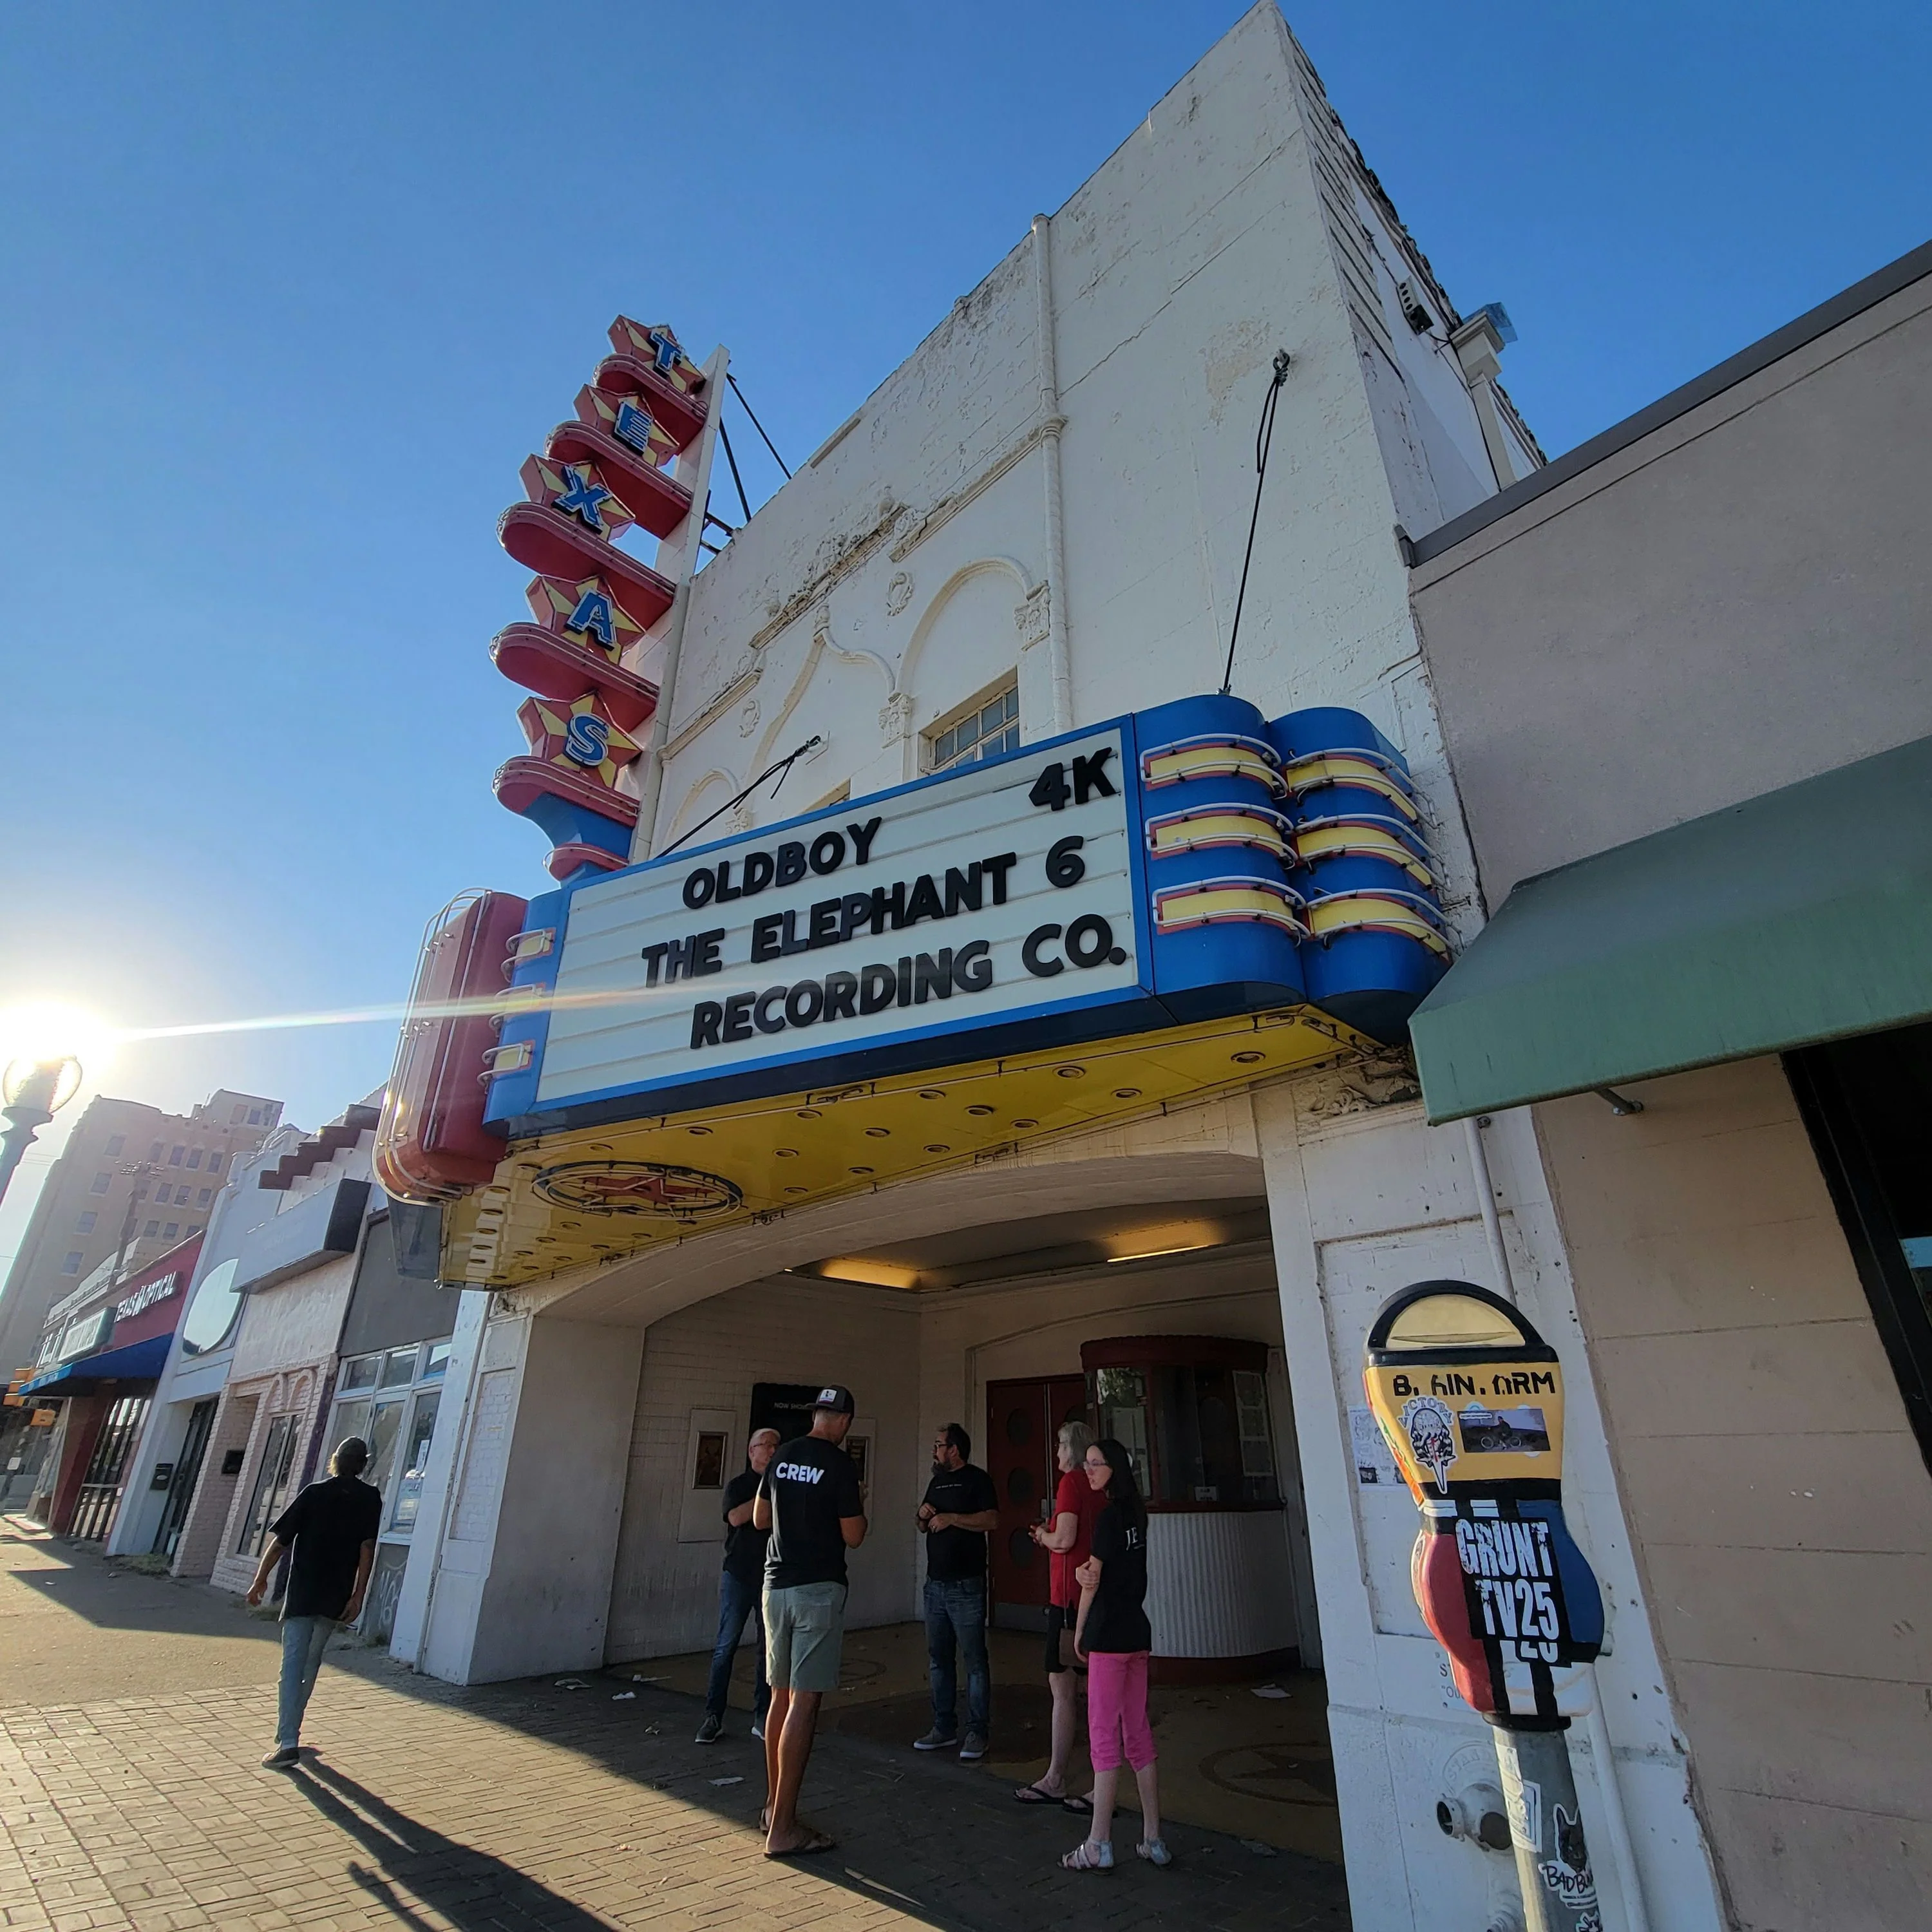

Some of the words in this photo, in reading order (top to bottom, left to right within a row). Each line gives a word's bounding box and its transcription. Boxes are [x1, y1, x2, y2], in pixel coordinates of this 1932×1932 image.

[552, 327, 683, 768] TEXAS
[682, 817, 882, 909] OLDBOY
[1028, 747, 1116, 811] 4K
[642, 927, 724, 988] THE
[750, 851, 1016, 963] ELEPHANT
[1046, 835, 1085, 888] 6
[690, 940, 992, 1049] RECORDING
[1022, 913, 1126, 978] CO.
[141, 1271, 176, 1309] OPTICAL
[1398, 1397, 1454, 1428] VICTORY
[775, 1462, 824, 1484] CREW
[1455, 1519, 1553, 1577] GRUNT
[1475, 1578, 1559, 1640] TV25
